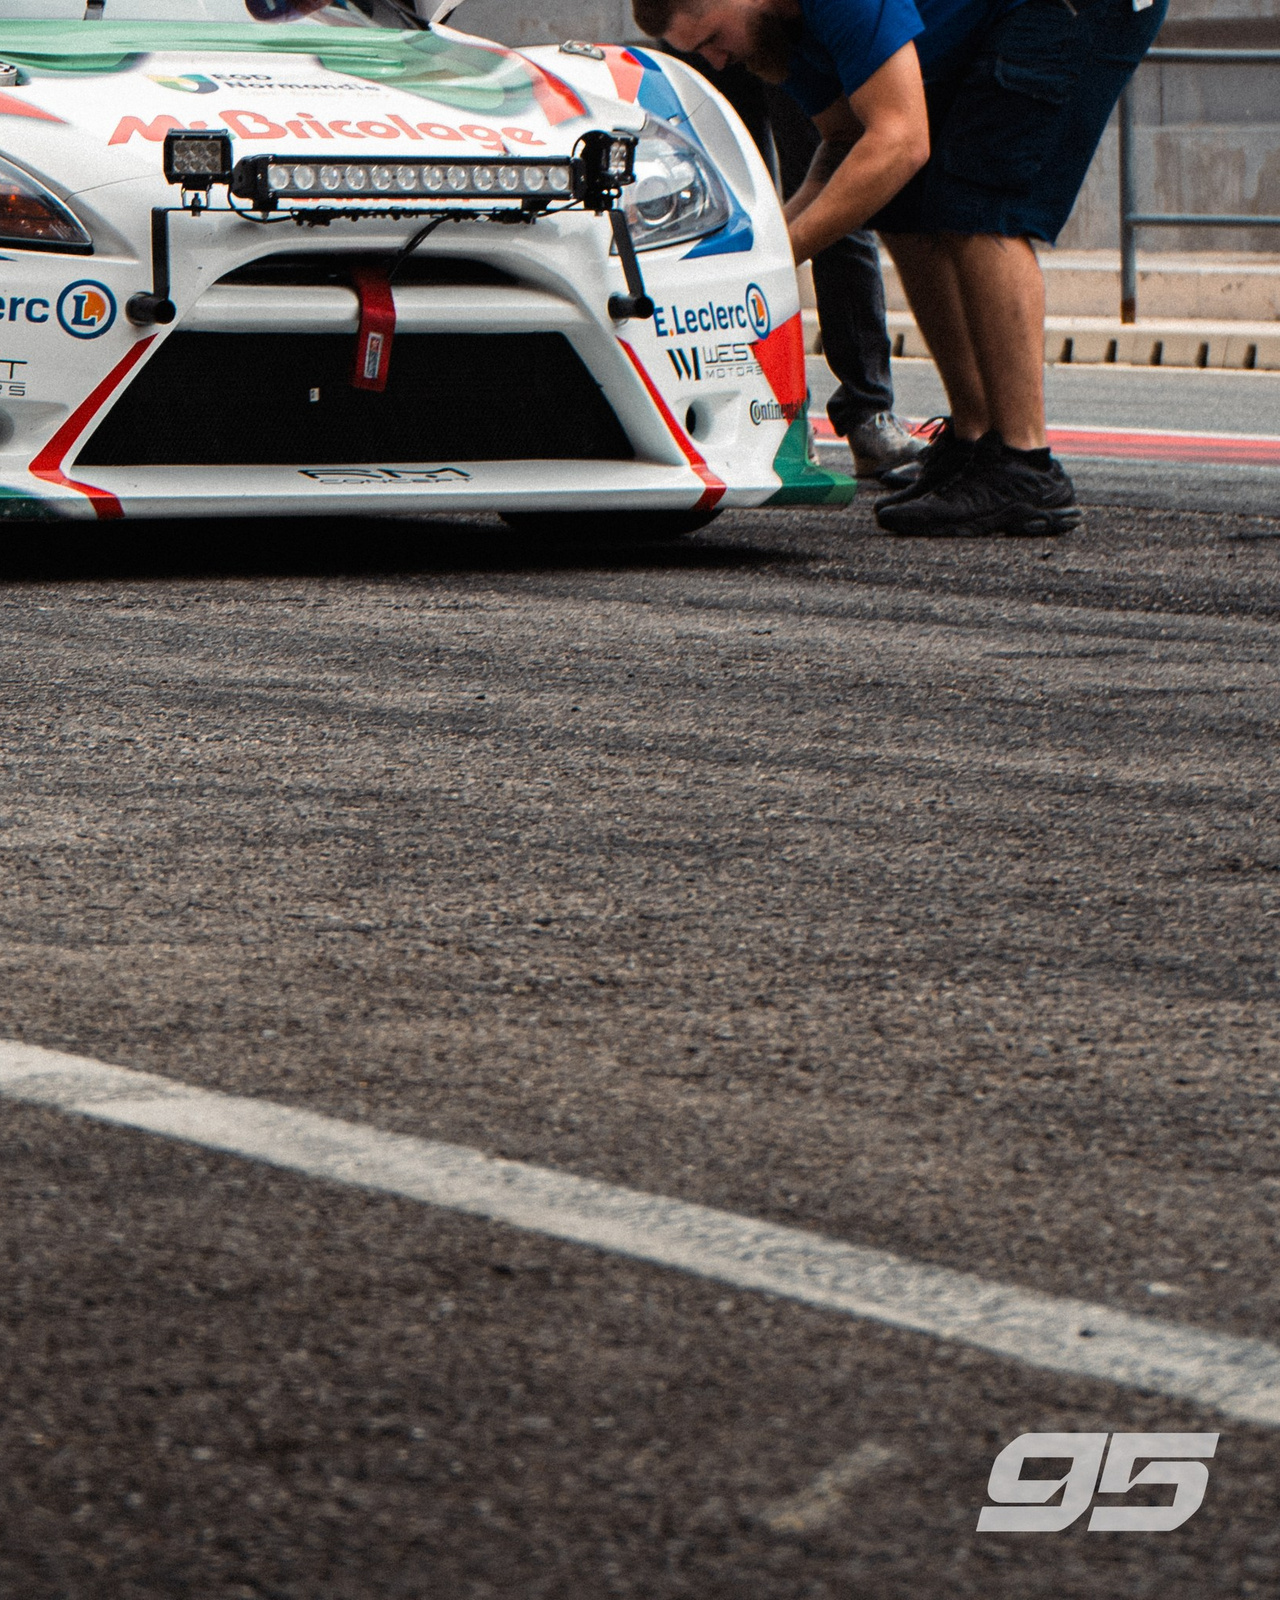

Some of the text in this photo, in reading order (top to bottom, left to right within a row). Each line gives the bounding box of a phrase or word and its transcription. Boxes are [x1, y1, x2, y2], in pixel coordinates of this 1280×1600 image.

[218, 109, 548, 151] Bricolage
[653, 301, 748, 337] E.Leclerc
[702, 342, 759, 364] WEST
[705, 365, 762, 379] MOTORS
